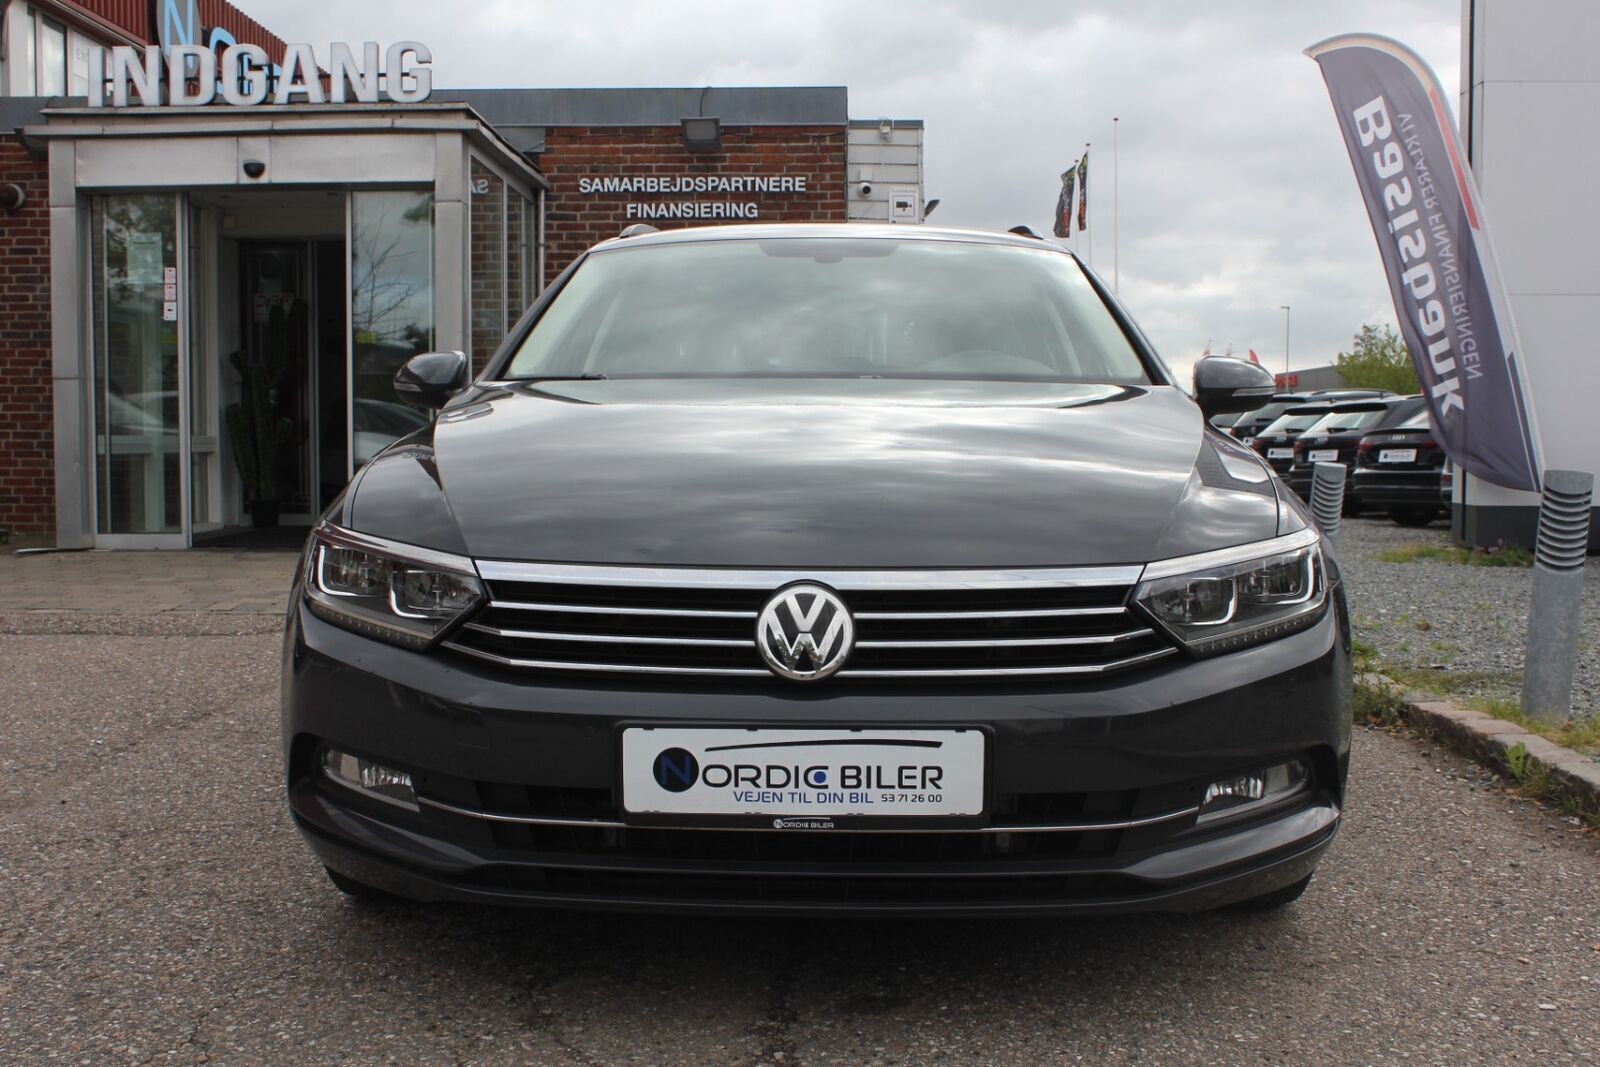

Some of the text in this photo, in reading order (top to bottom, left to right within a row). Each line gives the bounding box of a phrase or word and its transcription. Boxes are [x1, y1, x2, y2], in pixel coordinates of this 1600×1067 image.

[88, 41, 433, 107] INDGANG
[579, 176, 807, 194] SAMARBEJDSPARTNERE
[626, 202, 759, 219] FINANSIERING
[840, 765, 943, 790] BILER
[733, 791, 943, 804] VEJEN TIL DIN BIL 53 71 26 00
[810, 821, 835, 829] BILER
